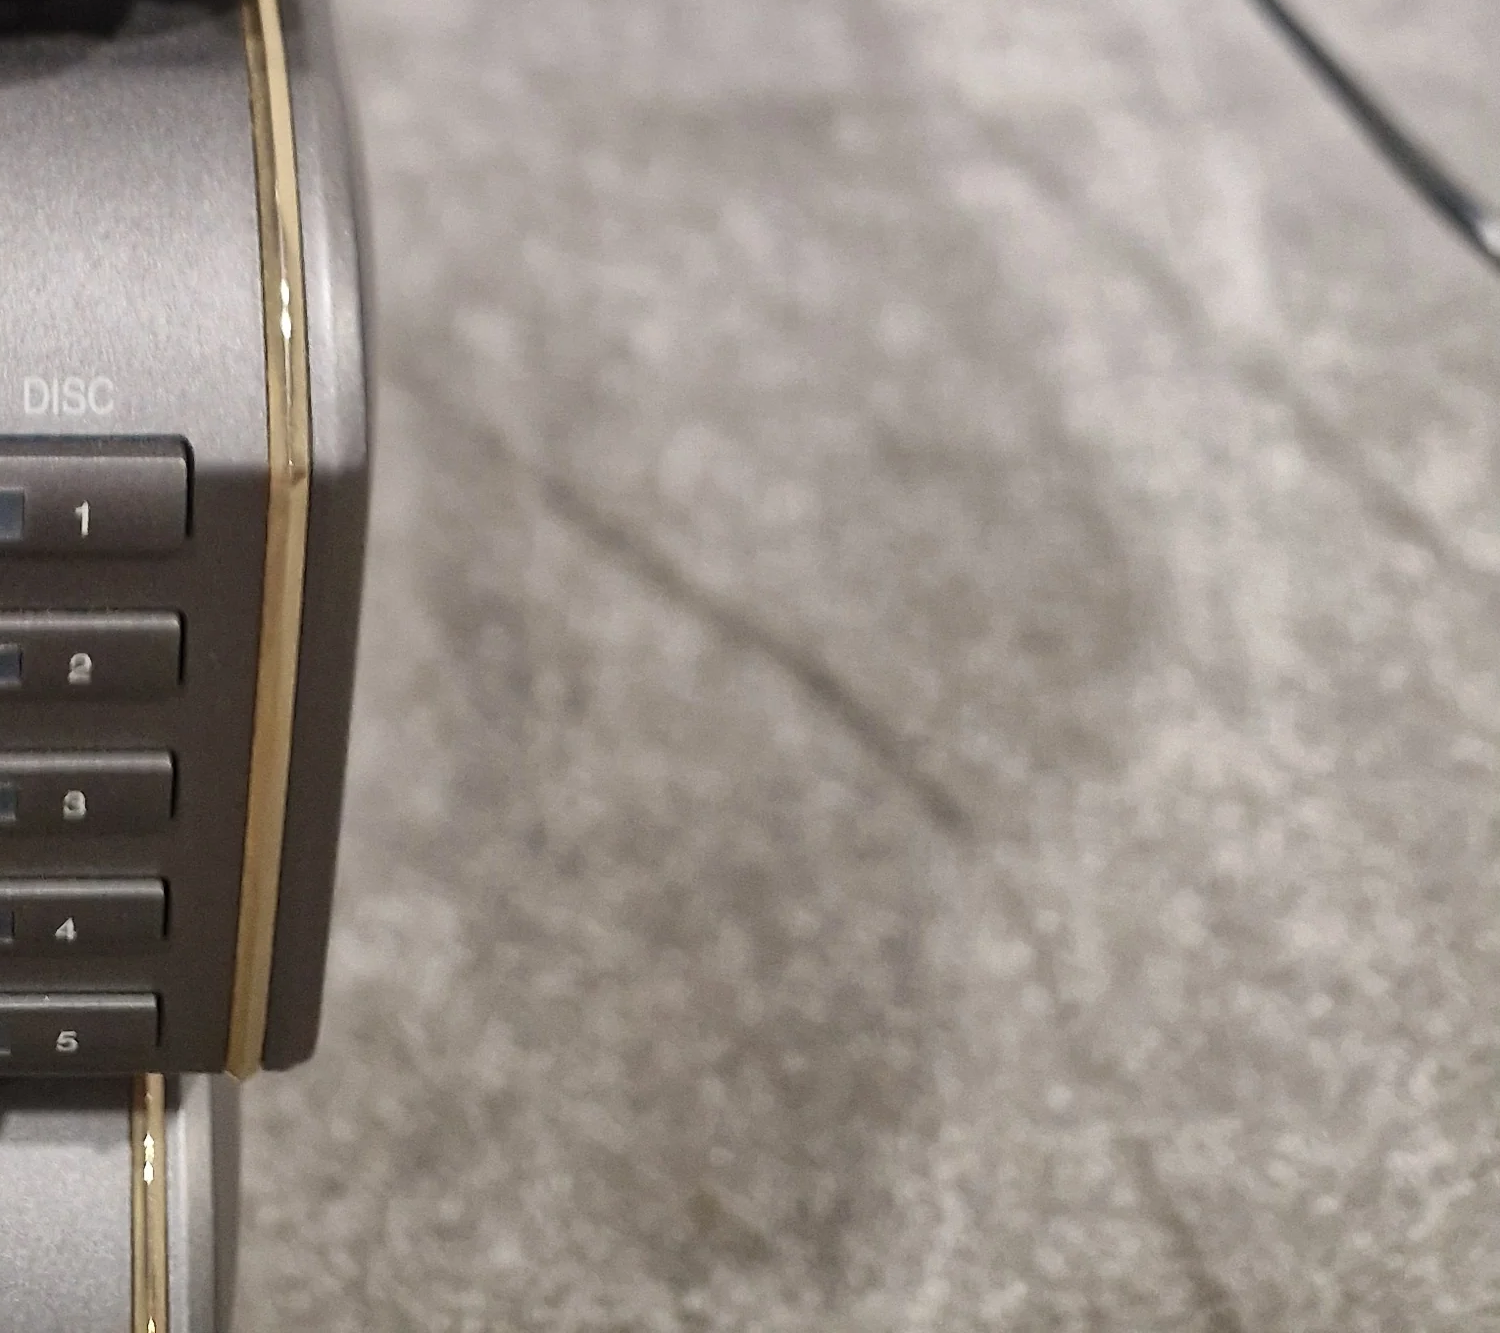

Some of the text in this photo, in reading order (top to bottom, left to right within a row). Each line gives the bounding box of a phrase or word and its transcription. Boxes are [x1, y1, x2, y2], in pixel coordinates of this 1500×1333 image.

[22, 376, 115, 416] DISC
[74, 500, 91, 536] 1
[53, 917, 76, 942] 4
[56, 1031, 79, 1053] 5
